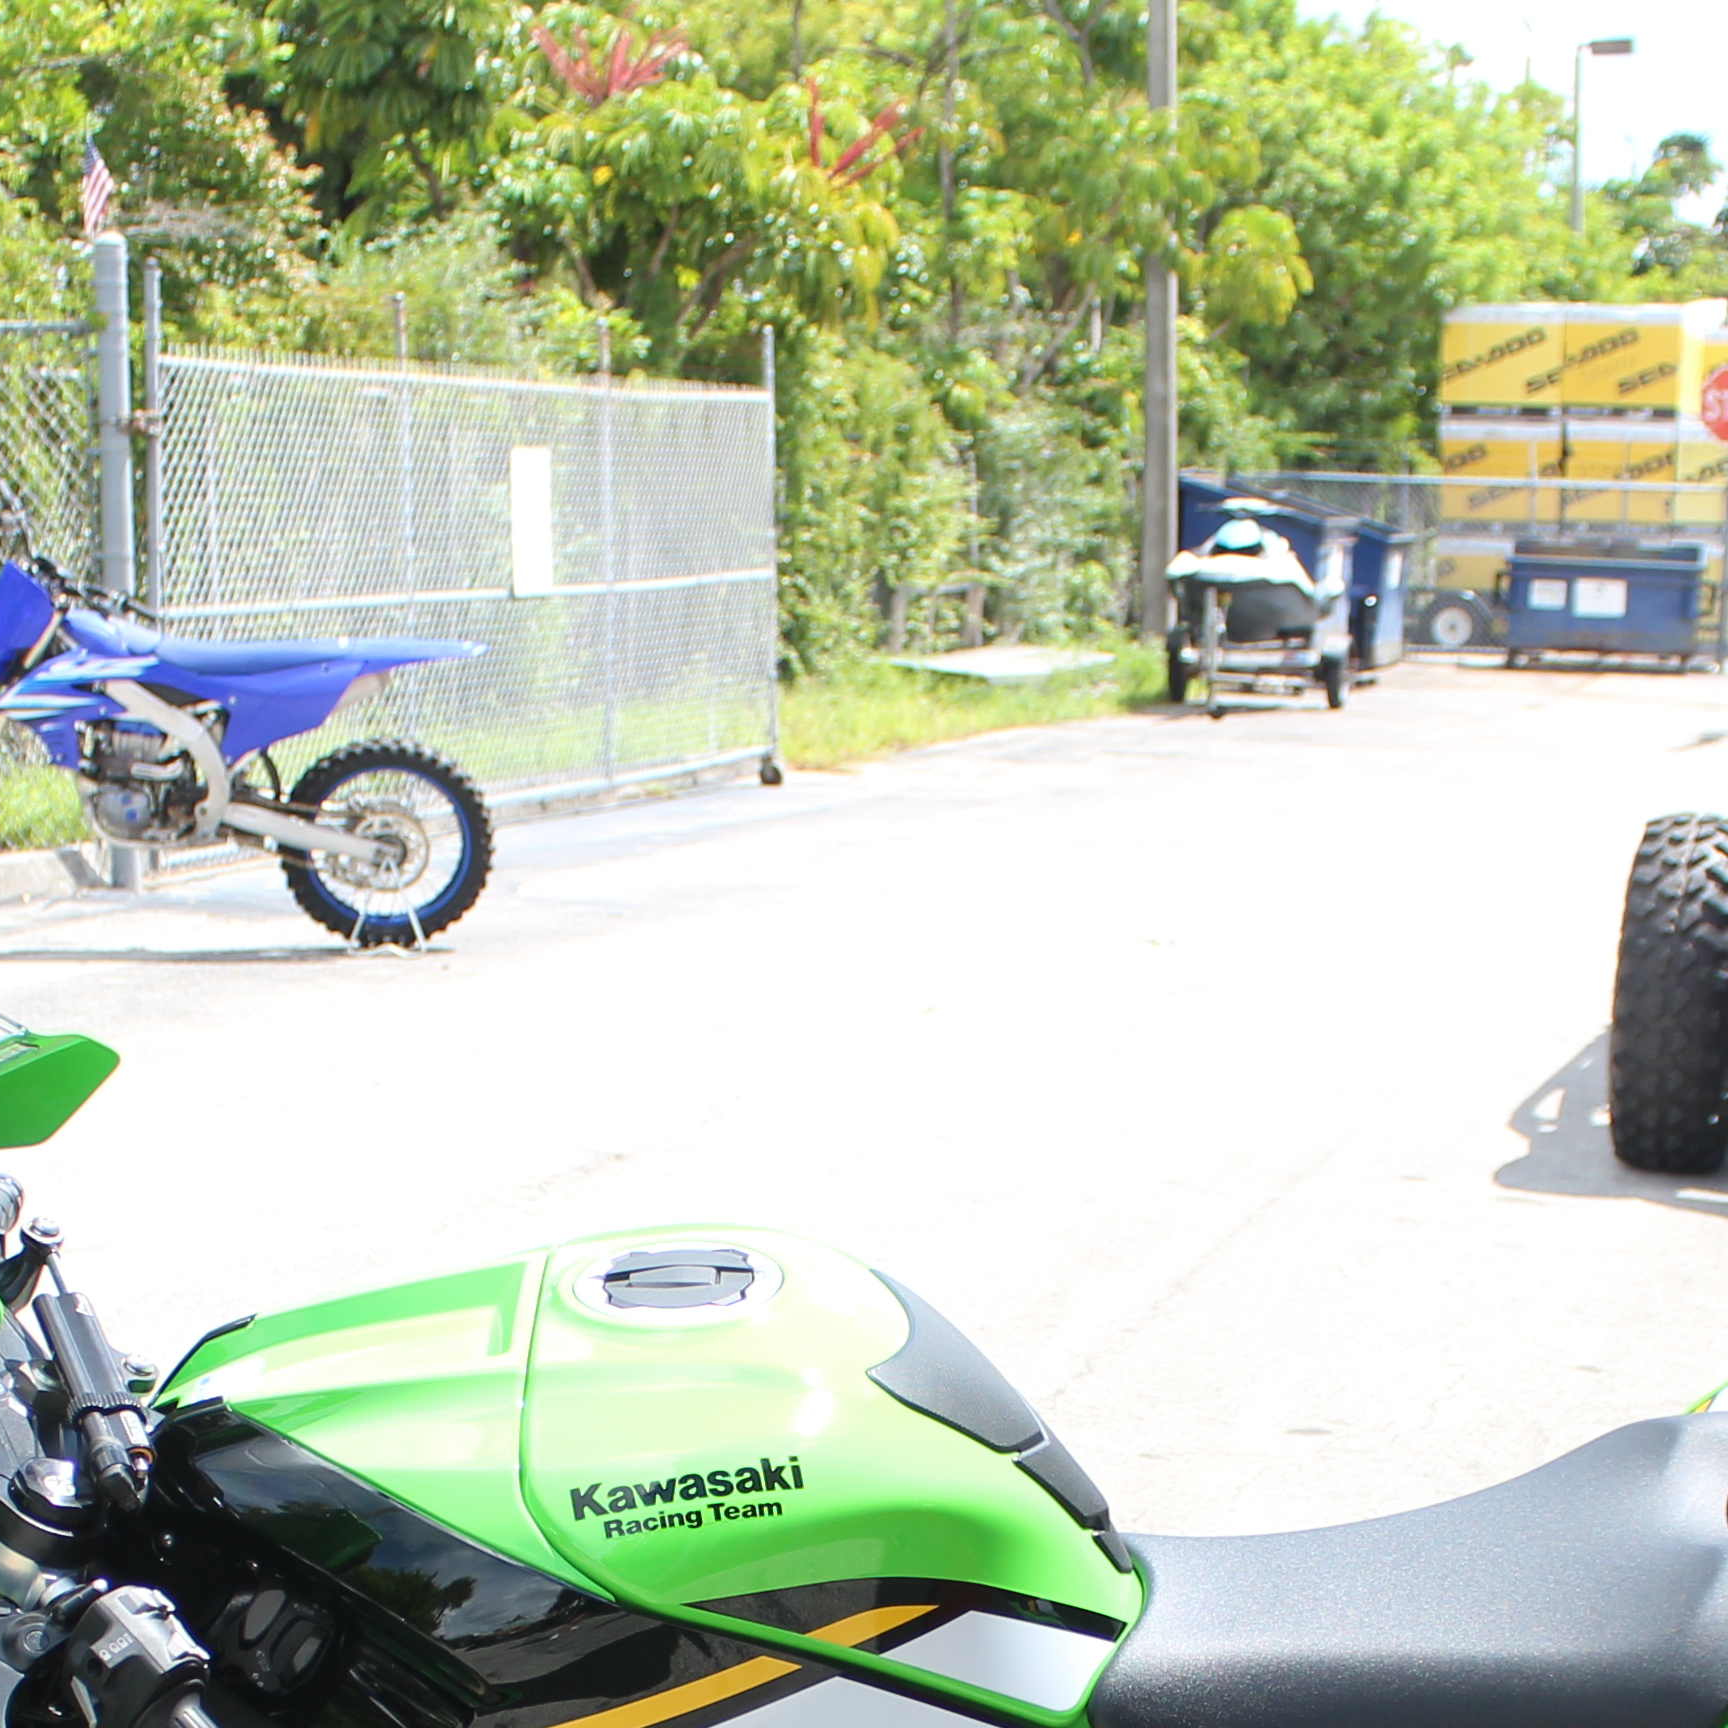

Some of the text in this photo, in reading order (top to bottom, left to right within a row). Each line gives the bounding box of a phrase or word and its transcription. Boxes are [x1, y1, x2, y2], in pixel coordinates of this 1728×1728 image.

[569, 1456, 804, 1521] Kawasaki
[603, 1501, 783, 1539] Racing Team
